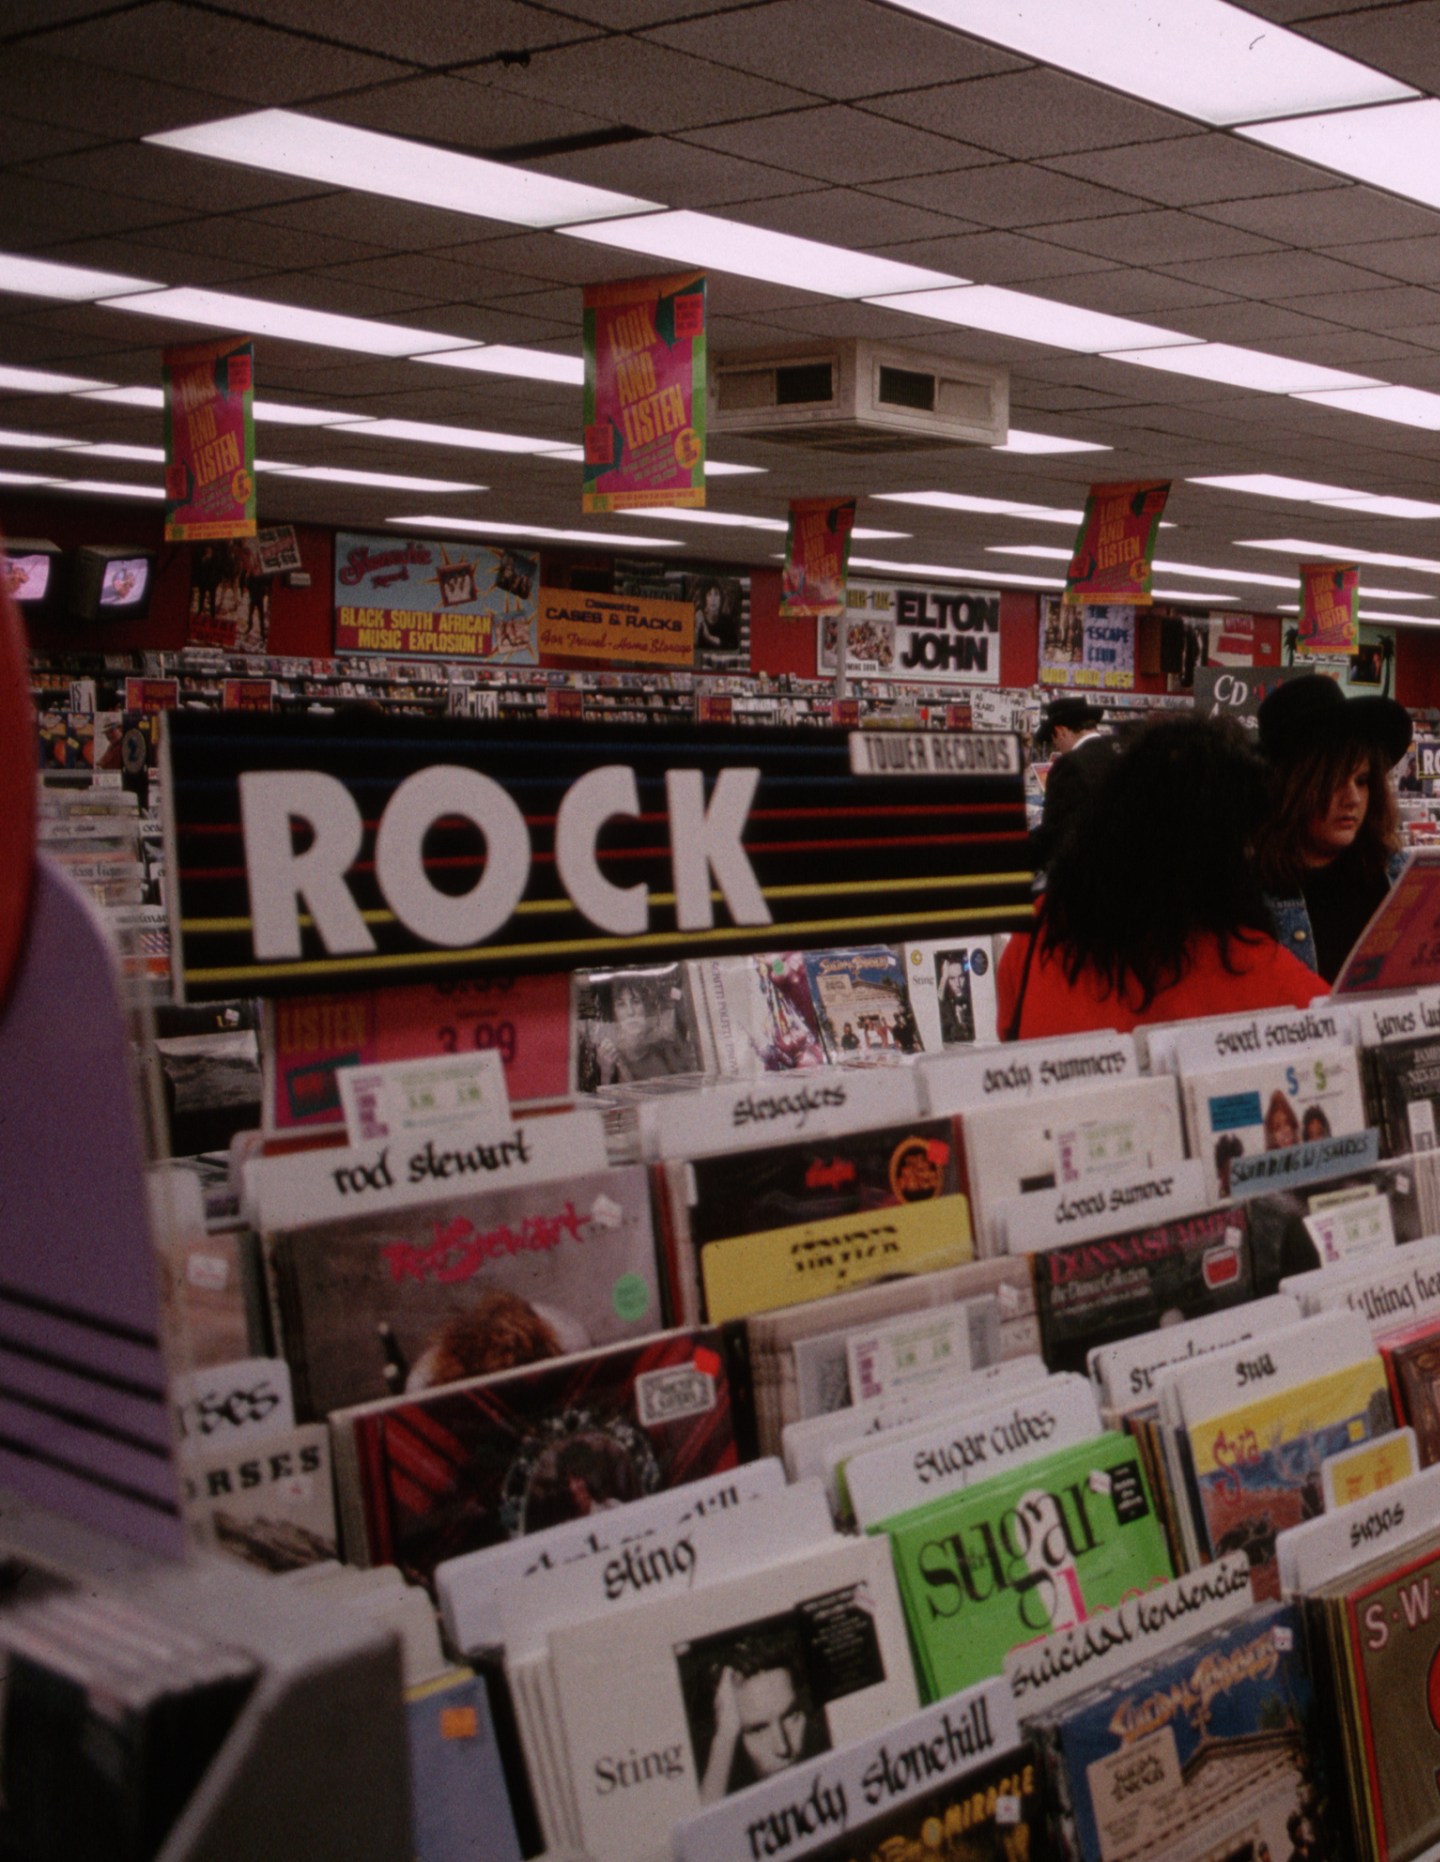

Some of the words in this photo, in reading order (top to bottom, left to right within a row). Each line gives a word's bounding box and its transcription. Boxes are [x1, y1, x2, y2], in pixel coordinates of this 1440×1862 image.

[607, 302, 656, 362] LOOK
[617, 351, 656, 406] AND
[624, 384, 686, 450] LISTEN
[193, 431, 240, 487] LISTEN
[1098, 521, 1124, 545] AND
[1099, 536, 1140, 570] LISTEN
[340, 607, 385, 625] BLACK
[391, 611, 433, 631] SOUTH
[438, 614, 491, 634] AFRICAN
[546, 607, 604, 624] CASES
[608, 613, 621, 625] &
[626, 614, 682, 632] RACKS
[897, 590, 999, 632] ELTON
[357, 629, 402, 650] MUSIC
[408, 633, 483, 654] EXPLOSION!
[902, 632, 988, 671] JOHN
[1087, 627, 1129, 643] ESCAPE
[974, 702, 995, 712] HEARD
[1214, 674, 1249, 706] CD
[864, 736, 928, 770] TOWER
[931, 736, 1010, 770] RECORDS
[238, 763, 774, 960] ROCK
[912, 975, 933, 986] Sting
[1215, 1020, 1260, 1055] sweet
[1265, 1012, 1337, 1050] sensation
[1374, 1008, 1417, 1040] james
[983, 1062, 1033, 1096] andy
[1040, 1050, 1128, 1085] summers
[732, 1086, 848, 1130] stranglers
[334, 1148, 394, 1198] rod
[407, 1130, 532, 1185] stewart
[1055, 1192, 1105, 1224] donna
[1110, 1176, 1174, 1212] summer
[914, 1431, 987, 1486] sugar
[990, 1408, 1057, 1456] cubes
[190, 1445, 322, 1498] RSES
[1351, 1502, 1405, 1548] swans
[603, 1533, 698, 1600] sting
[917, 1474, 1110, 1637] sugar
[1011, 1600, 1132, 1700] suicidal
[1136, 1562, 1251, 1637] tendencies
[594, 1743, 685, 1795] Sting
[745, 1773, 848, 1862] randy
[862, 1695, 995, 1804] stonehill
